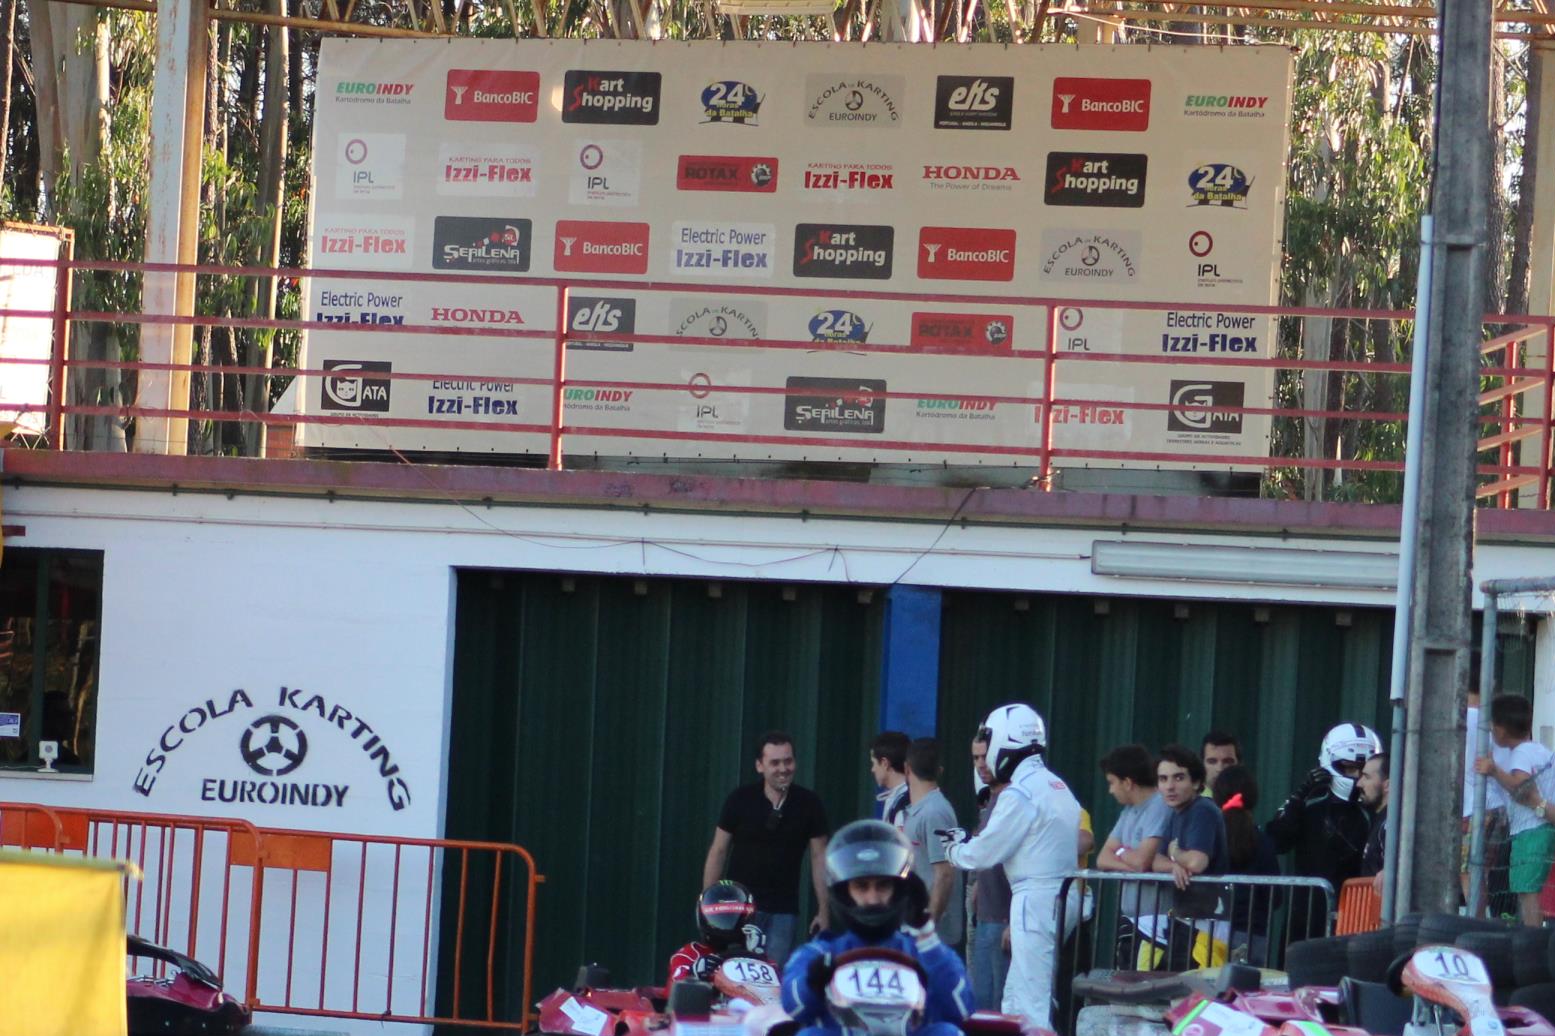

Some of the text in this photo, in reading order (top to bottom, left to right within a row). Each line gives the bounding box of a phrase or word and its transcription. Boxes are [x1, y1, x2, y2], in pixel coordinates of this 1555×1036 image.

[336, 82, 414, 95] EUROINDY
[587, 76, 624, 92] Kart
[473, 90, 534, 105] BancoBIC
[569, 84, 653, 112] Shopping
[709, 83, 745, 106] 24
[809, 81, 847, 120] ESCOLA
[857, 80, 899, 121] KARTING
[1185, 95, 1268, 108] EUROINDY
[1081, 98, 1144, 113] BancoBIC
[829, 112, 877, 122] EUROINDY
[445, 165, 532, 182] Izzi-Flex
[922, 166, 1021, 181] HONDA
[1071, 159, 1109, 173] Kart
[353, 171, 374, 184] IPL
[588, 176, 610, 190] IPL
[804, 170, 893, 189] Izzi-Flex
[1052, 167, 1139, 194] Shopping
[1196, 166, 1234, 189] 24
[321, 236, 406, 253] Izzi-Flex
[681, 227, 767, 245] Electric Power
[819, 230, 855, 245] Kart
[583, 242, 643, 256] BancoBIC
[800, 239, 886, 266] Shopping
[947, 248, 1009, 263] BancoBIC
[1044, 236, 1083, 274] ESCOLA
[1093, 235, 1136, 277] KARTING
[676, 249, 768, 268] Izzi-Flex
[1065, 268, 1114, 277] EUROINDY
[1198, 263, 1220, 277] IPL
[321, 291, 403, 308] Electric Power
[431, 307, 525, 324] HONDA
[676, 307, 710, 337] SCOLA
[721, 306, 761, 340] KARTIN
[816, 312, 853, 335] 24
[1167, 312, 1255, 329] Electric Power
[1068, 337, 1090, 351] IPL
[1162, 333, 1257, 353] Izzi-Flex
[564, 389, 633, 402] UROINDY
[428, 395, 518, 415] Izzi-Flex
[696, 405, 718, 418] IPL
[917, 399, 997, 410] EUROINDY
[1034, 405, 1125, 424] Izi-Flex
[132, 686, 412, 811] ESCOLA KARTING
[201, 778, 350, 807] EUROINDY
[735, 962, 772, 981] 158
[1434, 952, 1469, 976] 10
[848, 967, 905, 994] 144
